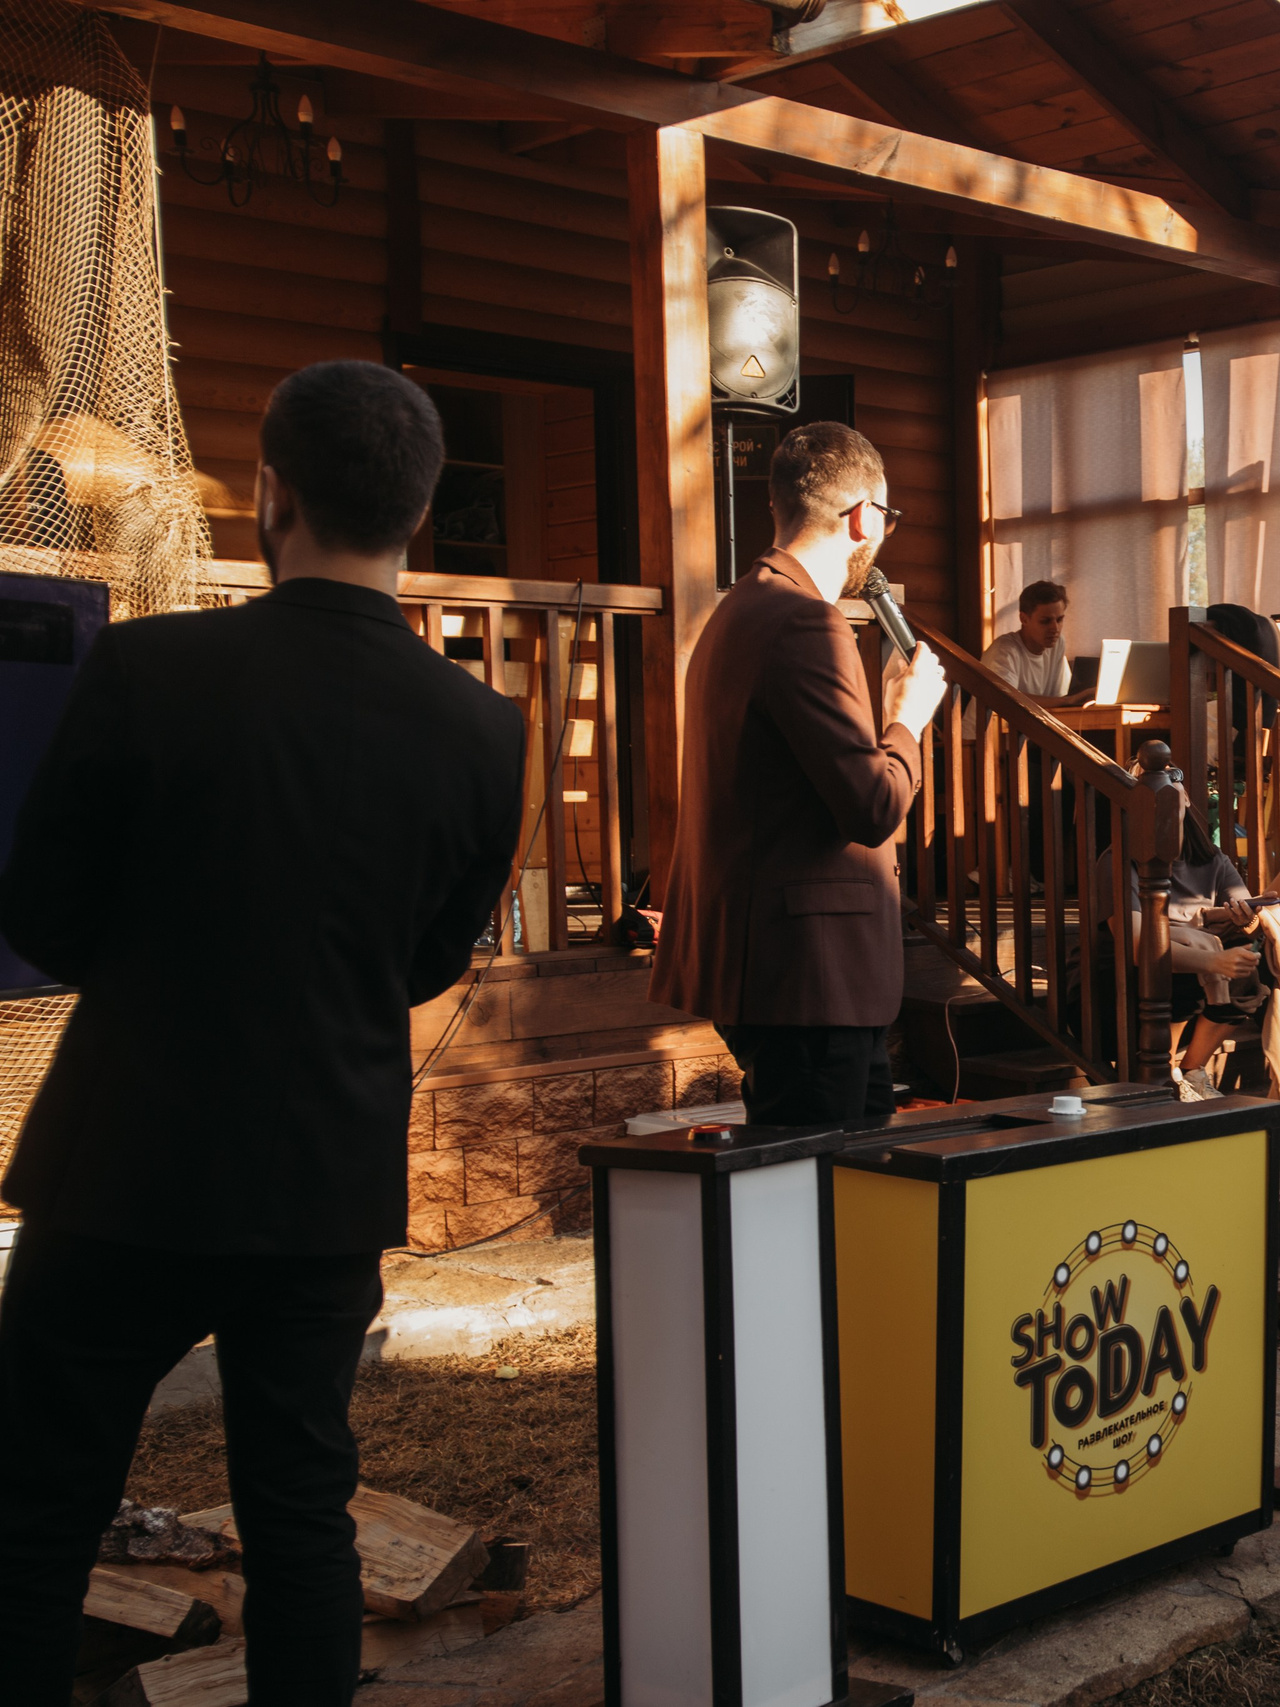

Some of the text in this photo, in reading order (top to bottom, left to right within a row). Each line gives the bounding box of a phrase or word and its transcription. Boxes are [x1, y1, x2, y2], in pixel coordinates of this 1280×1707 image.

[1011, 1274, 1127, 1368] SHOW
[1014, 1285, 1218, 1449] TODAY
[1078, 1401, 1165, 1450] РАЗВЛЕКАТЕЛЬНОЕ
[1113, 1431, 1134, 1449] ШОУ
